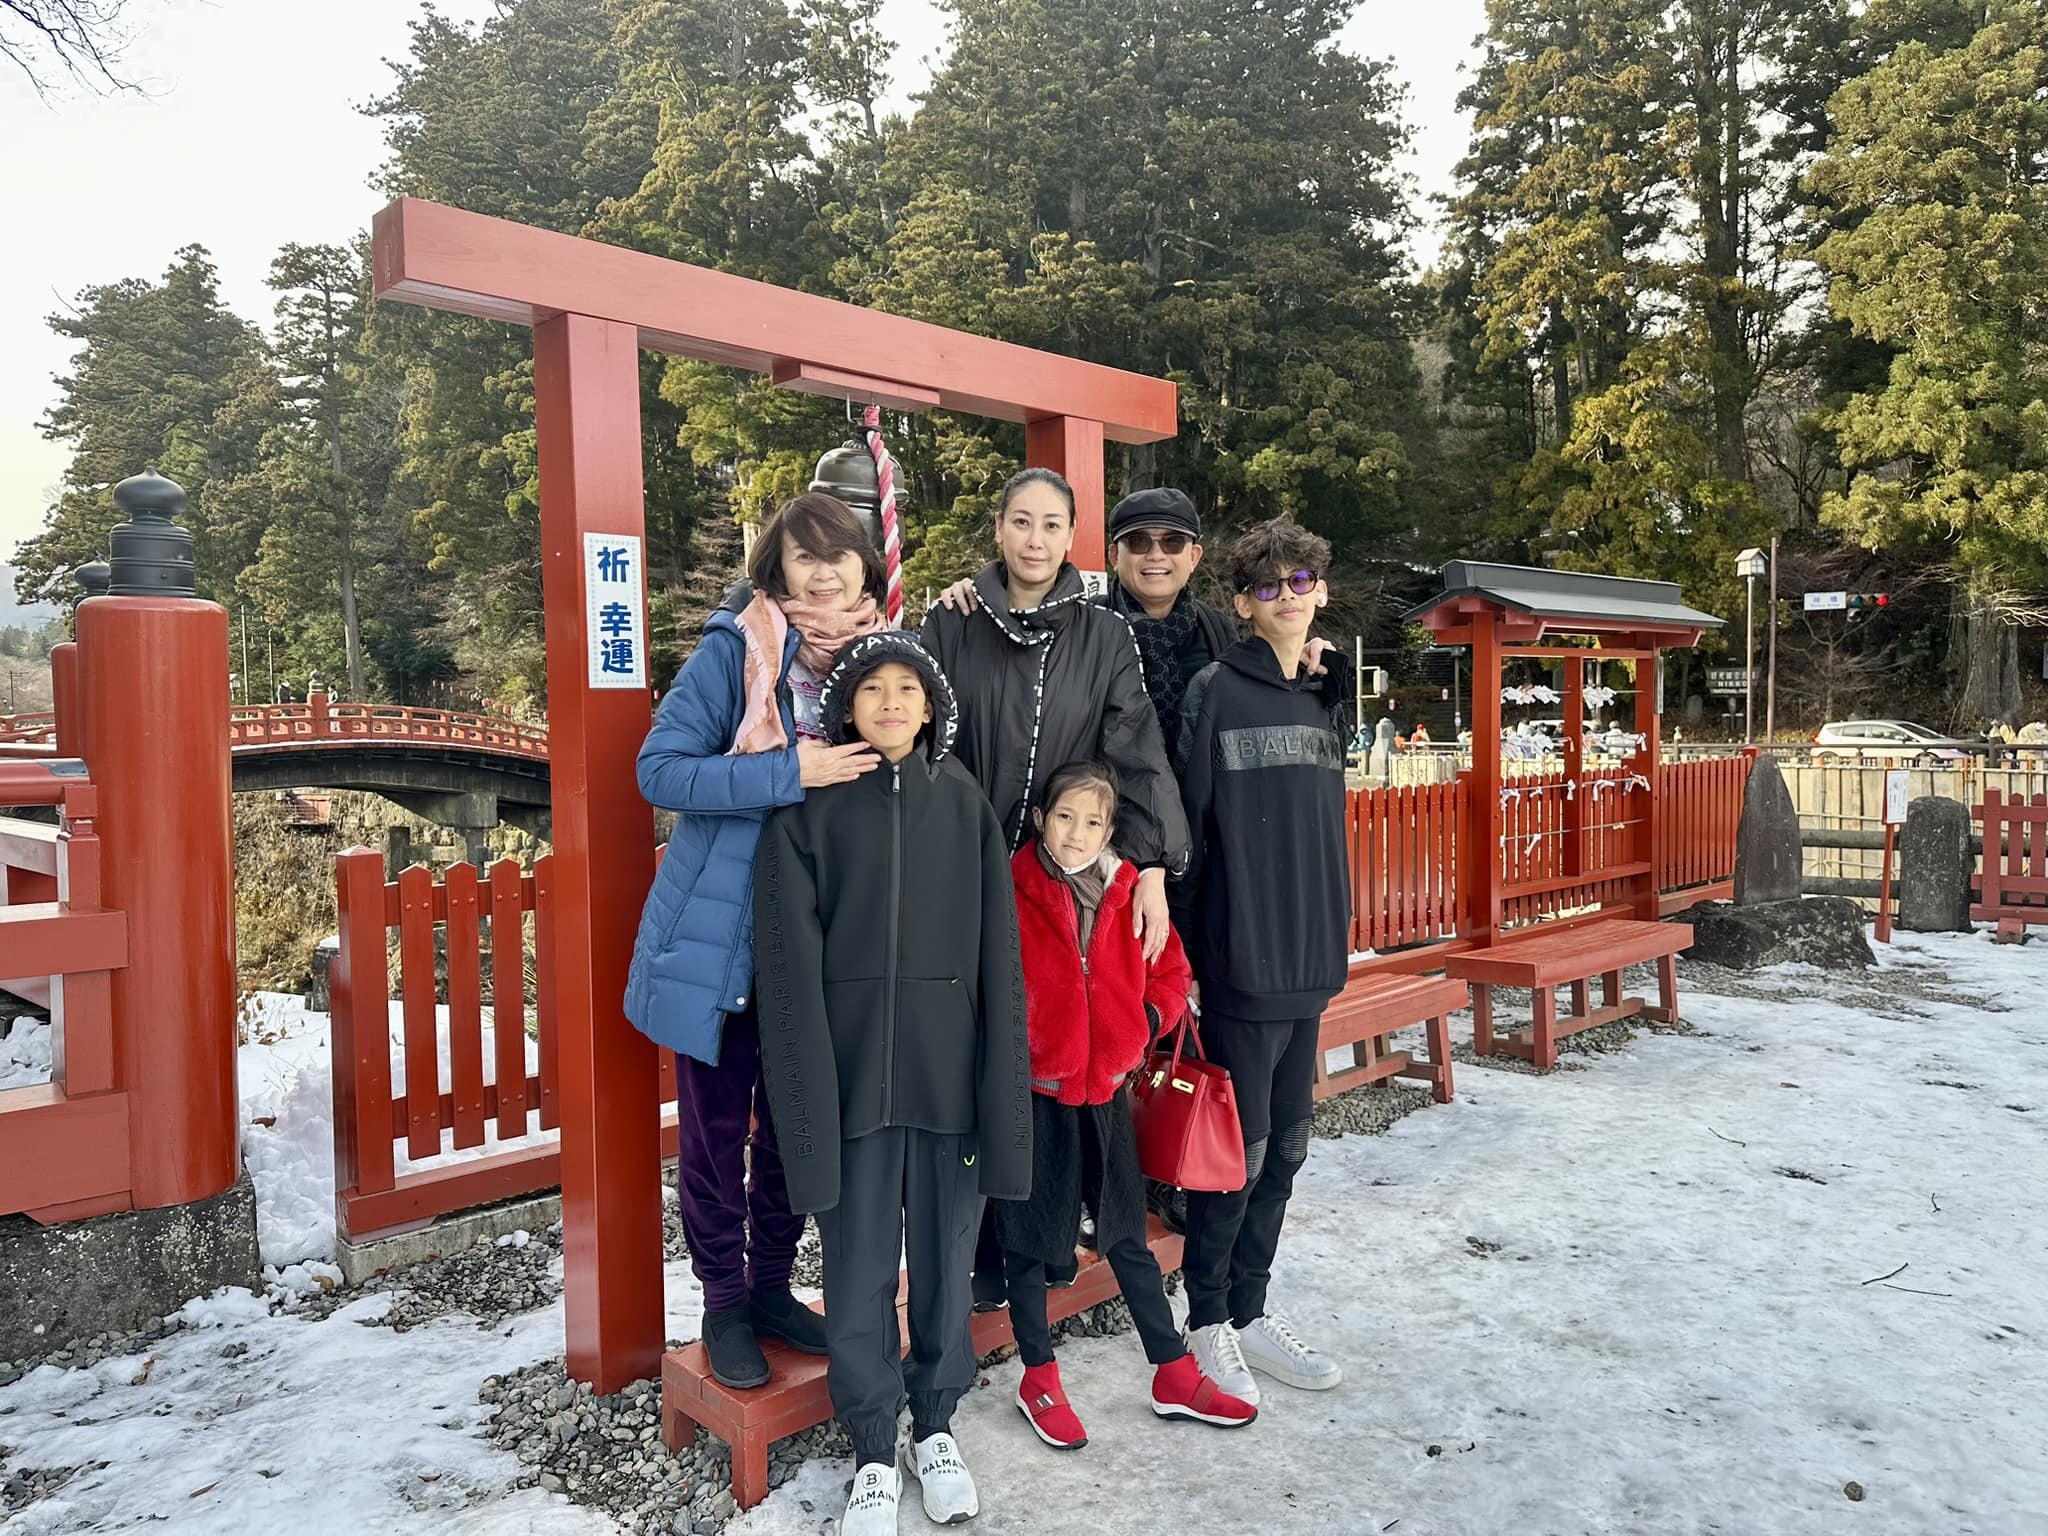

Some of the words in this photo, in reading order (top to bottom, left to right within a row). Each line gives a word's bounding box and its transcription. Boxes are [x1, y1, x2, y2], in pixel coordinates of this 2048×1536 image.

[597, 546, 633, 673] 祈幸運
[770, 960, 795, 1032] PARIS
[783, 1040, 816, 1158] BALMAIN
[922, 1458, 958, 1475] BALMA
[849, 1490, 895, 1510] BALMAIN
[860, 1501, 882, 1511] PARIS
